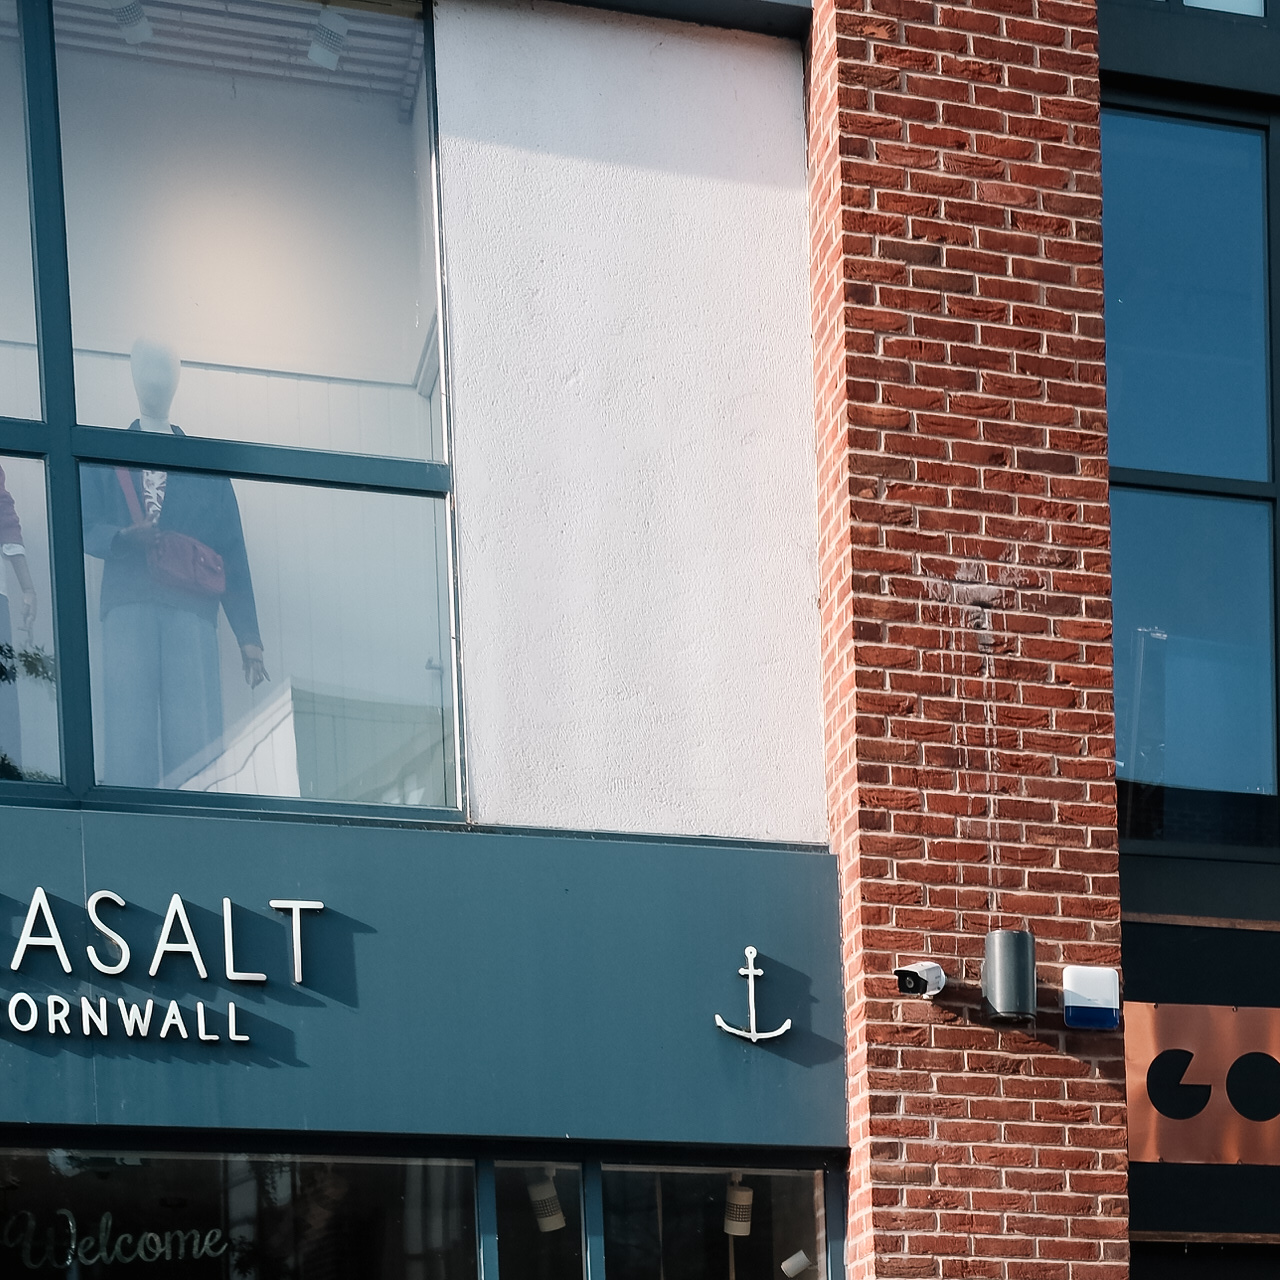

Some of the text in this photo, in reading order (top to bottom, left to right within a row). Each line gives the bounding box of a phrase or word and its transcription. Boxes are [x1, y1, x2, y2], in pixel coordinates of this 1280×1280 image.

[10, 886, 325, 983] ASALT
[8, 991, 250, 1042] ORNWALL
[4, 1208, 229, 1270] Welcome
